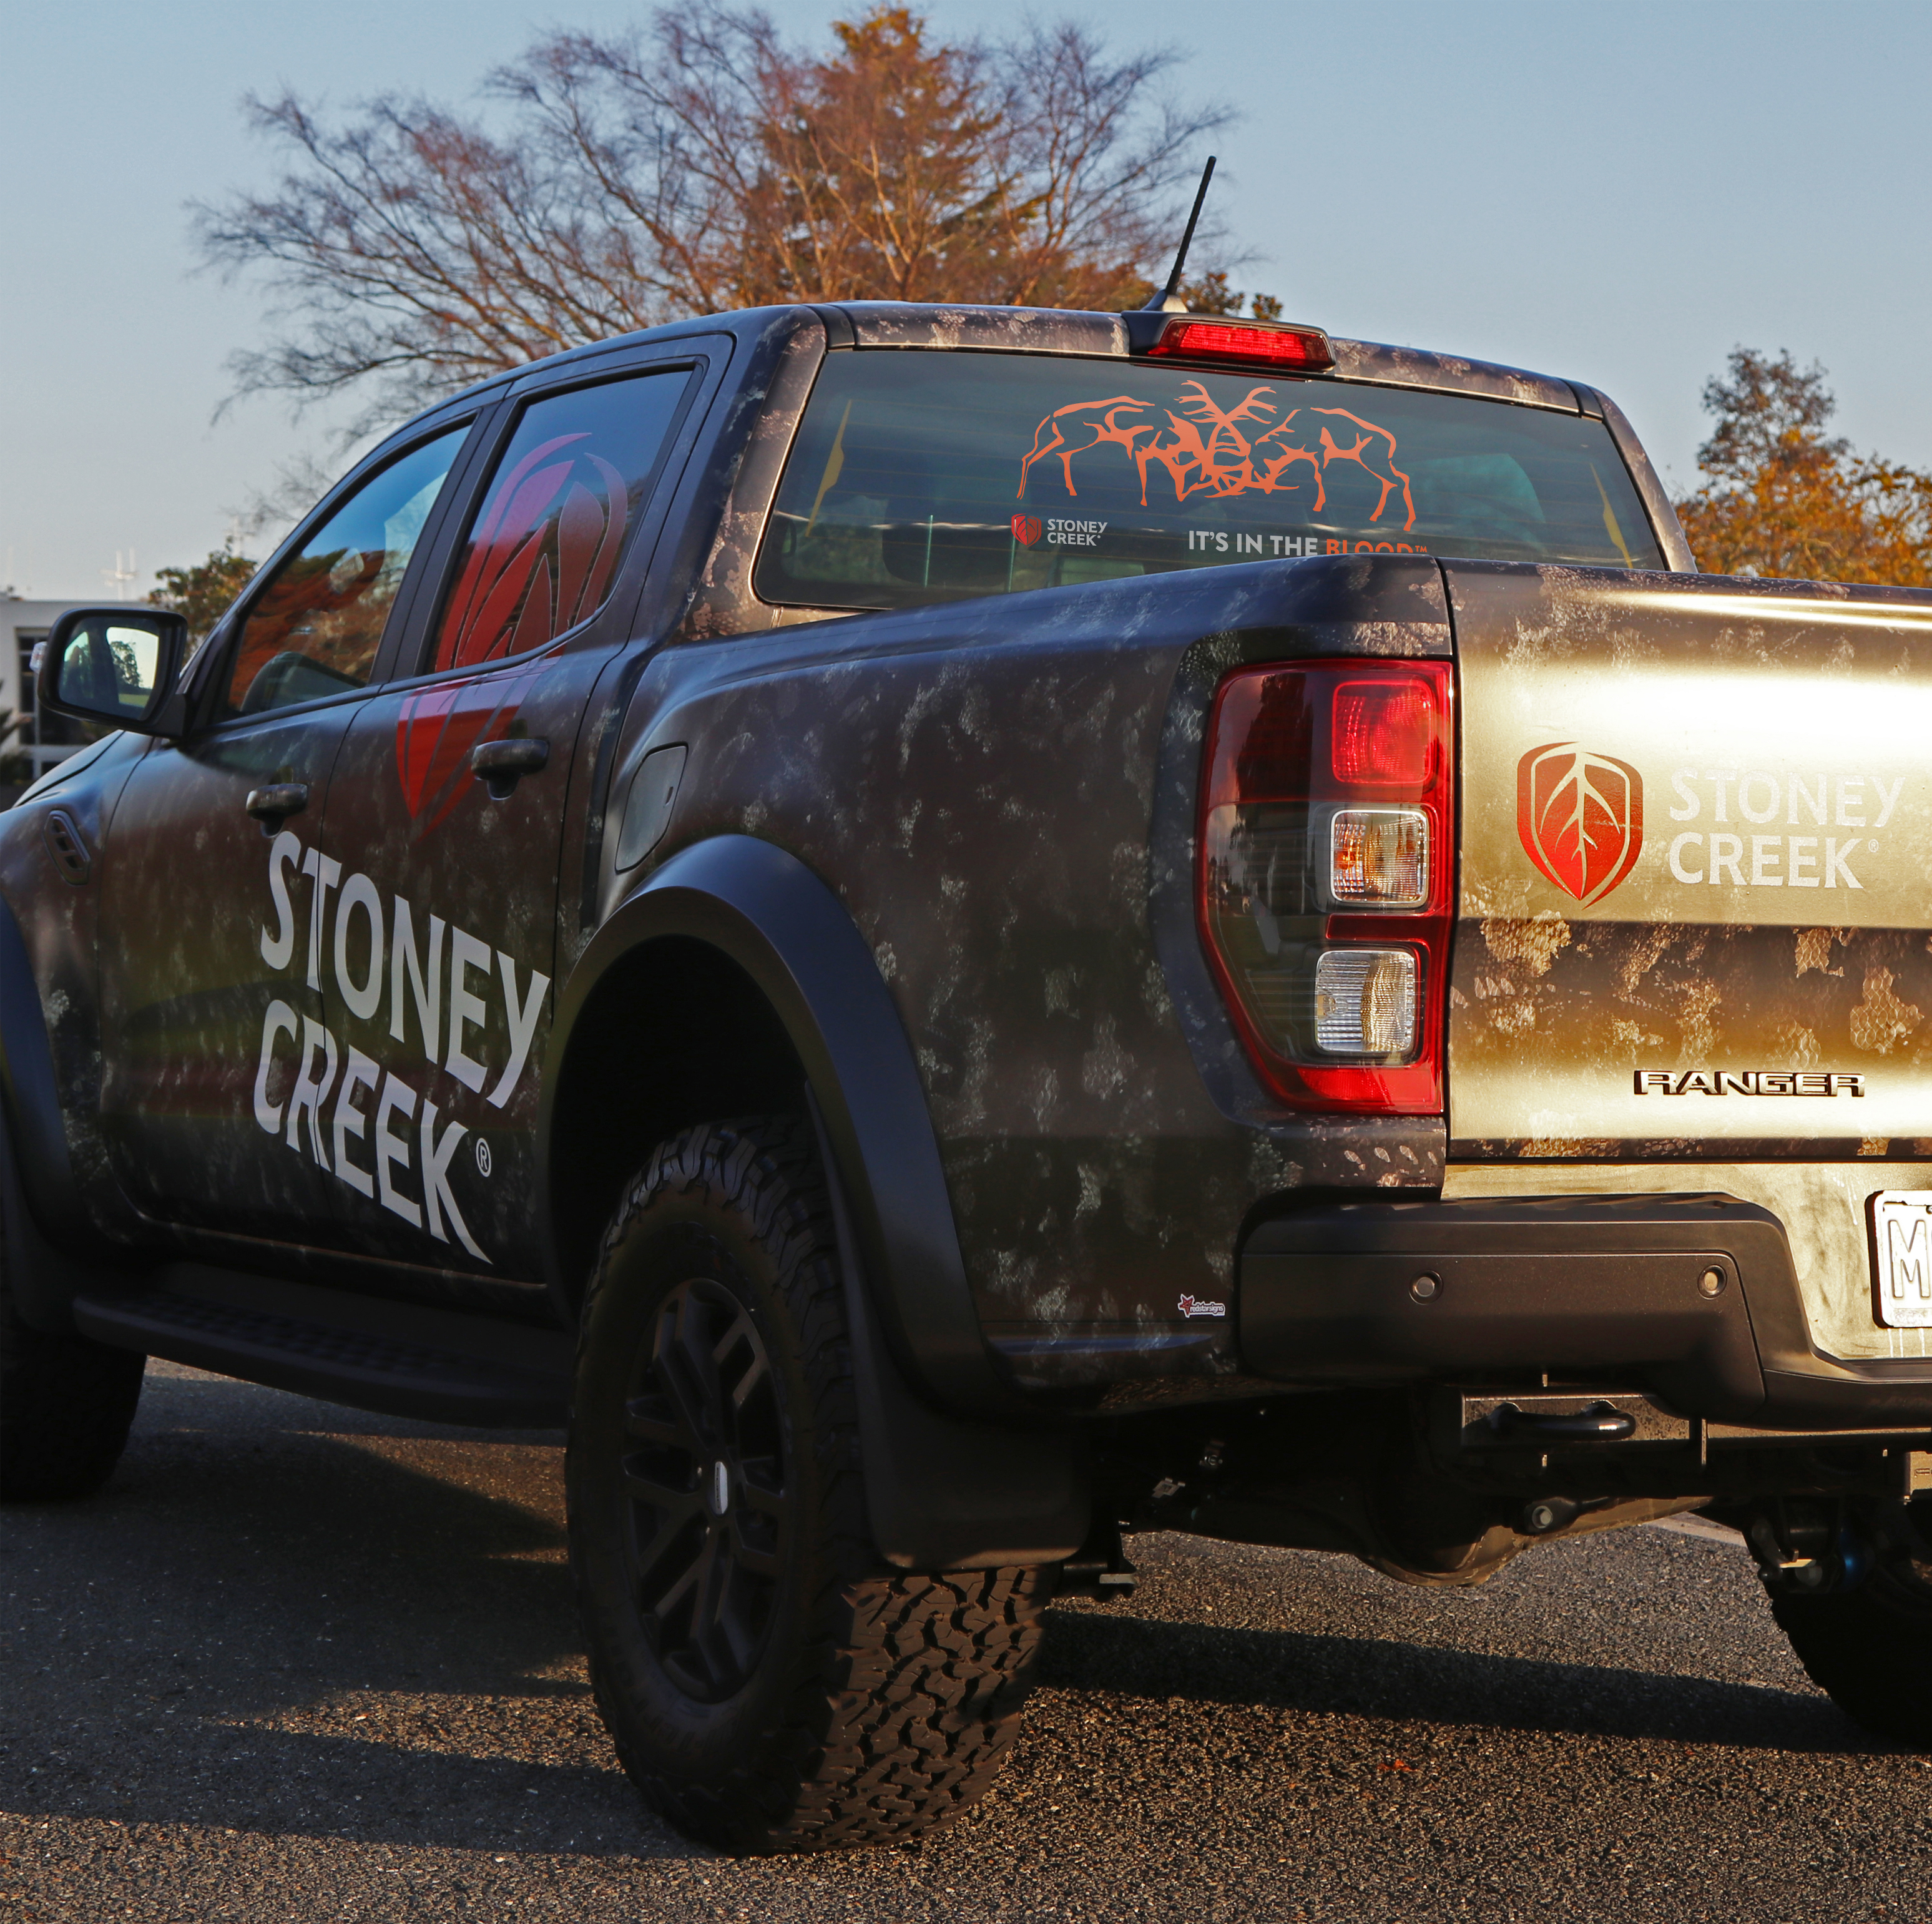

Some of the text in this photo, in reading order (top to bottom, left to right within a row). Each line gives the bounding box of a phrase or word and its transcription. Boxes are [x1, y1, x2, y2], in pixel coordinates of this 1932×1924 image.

[1047, 518, 1108, 533] STONEY
[1189, 531, 1228, 552] IT'S
[1237, 533, 1262, 554] IN
[1270, 535, 1318, 556] THE
[1669, 767, 1906, 828] STONEY
[260, 831, 551, 1109] STONEY
[1634, 1070, 1865, 1097] RANGER
[1190, 1305, 1223, 1313] redstarsigns
